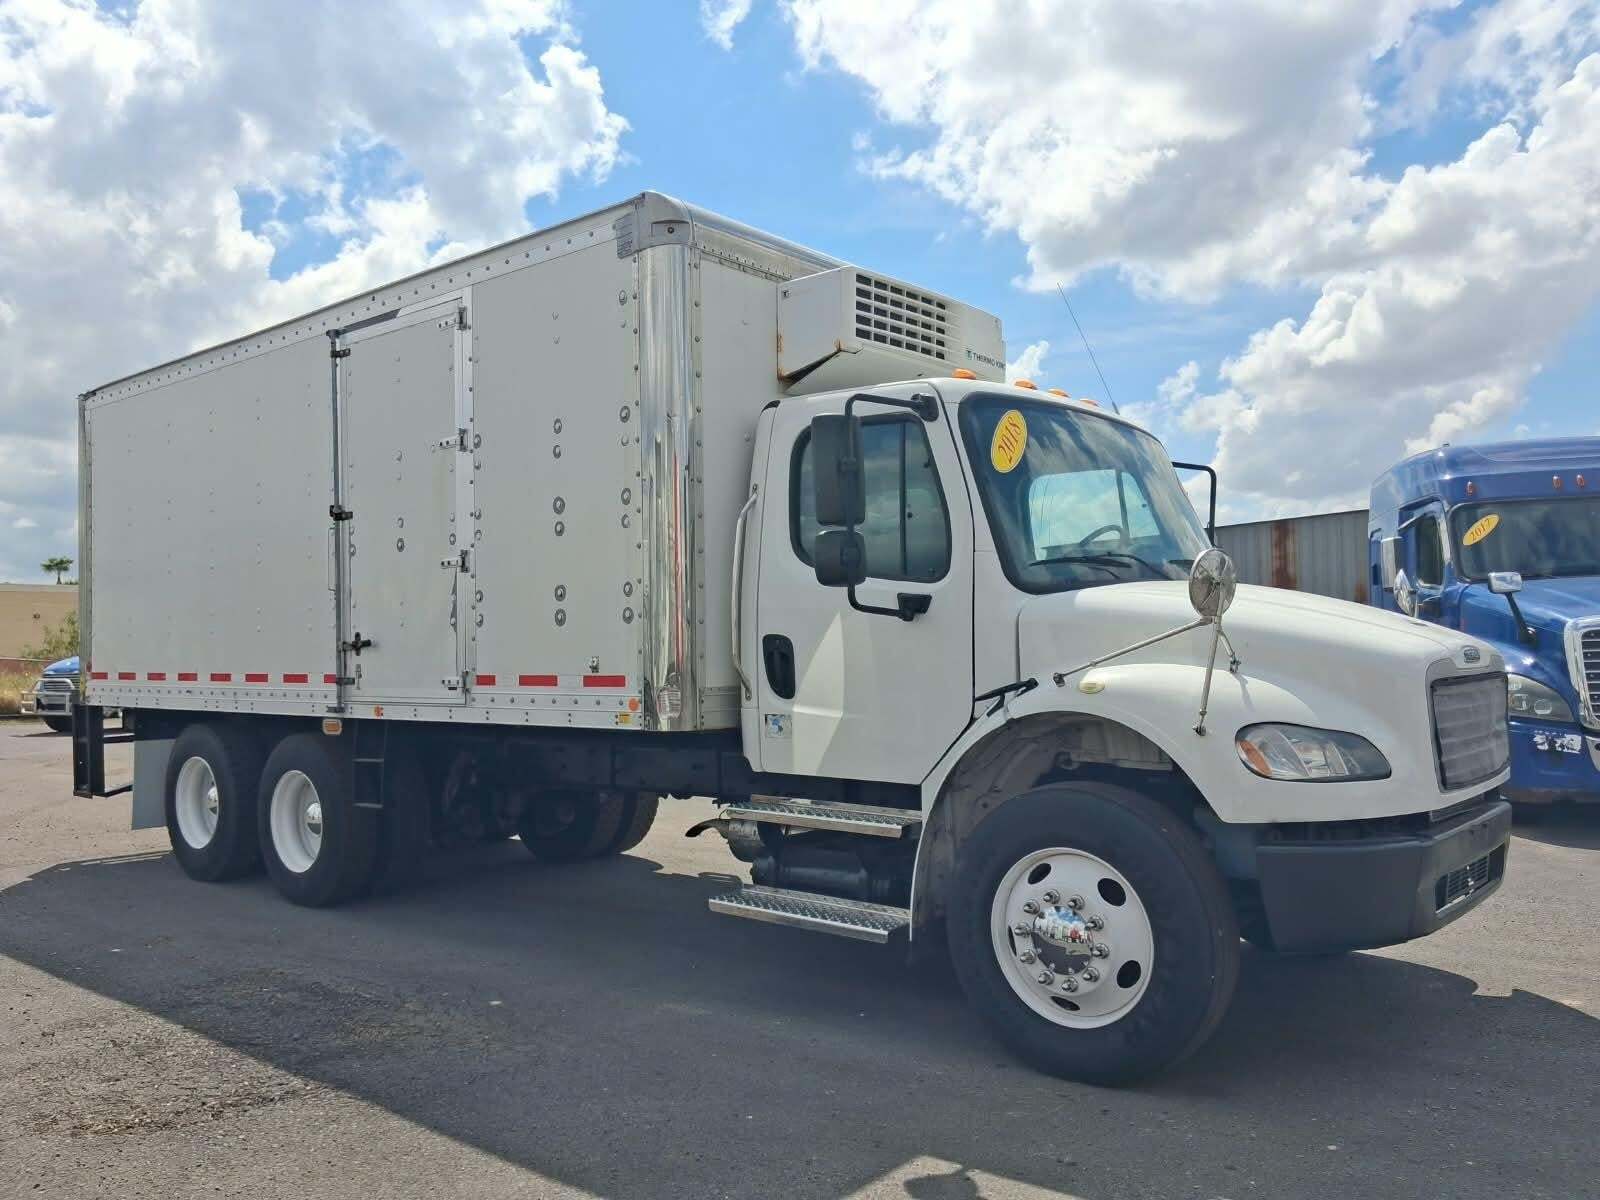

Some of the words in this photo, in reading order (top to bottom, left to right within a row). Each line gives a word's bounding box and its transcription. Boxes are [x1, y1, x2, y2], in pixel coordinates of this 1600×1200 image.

[973, 352, 996, 367] THERMO
[998, 416, 1021, 464] 2018
[1470, 518, 1491, 541] 2017
